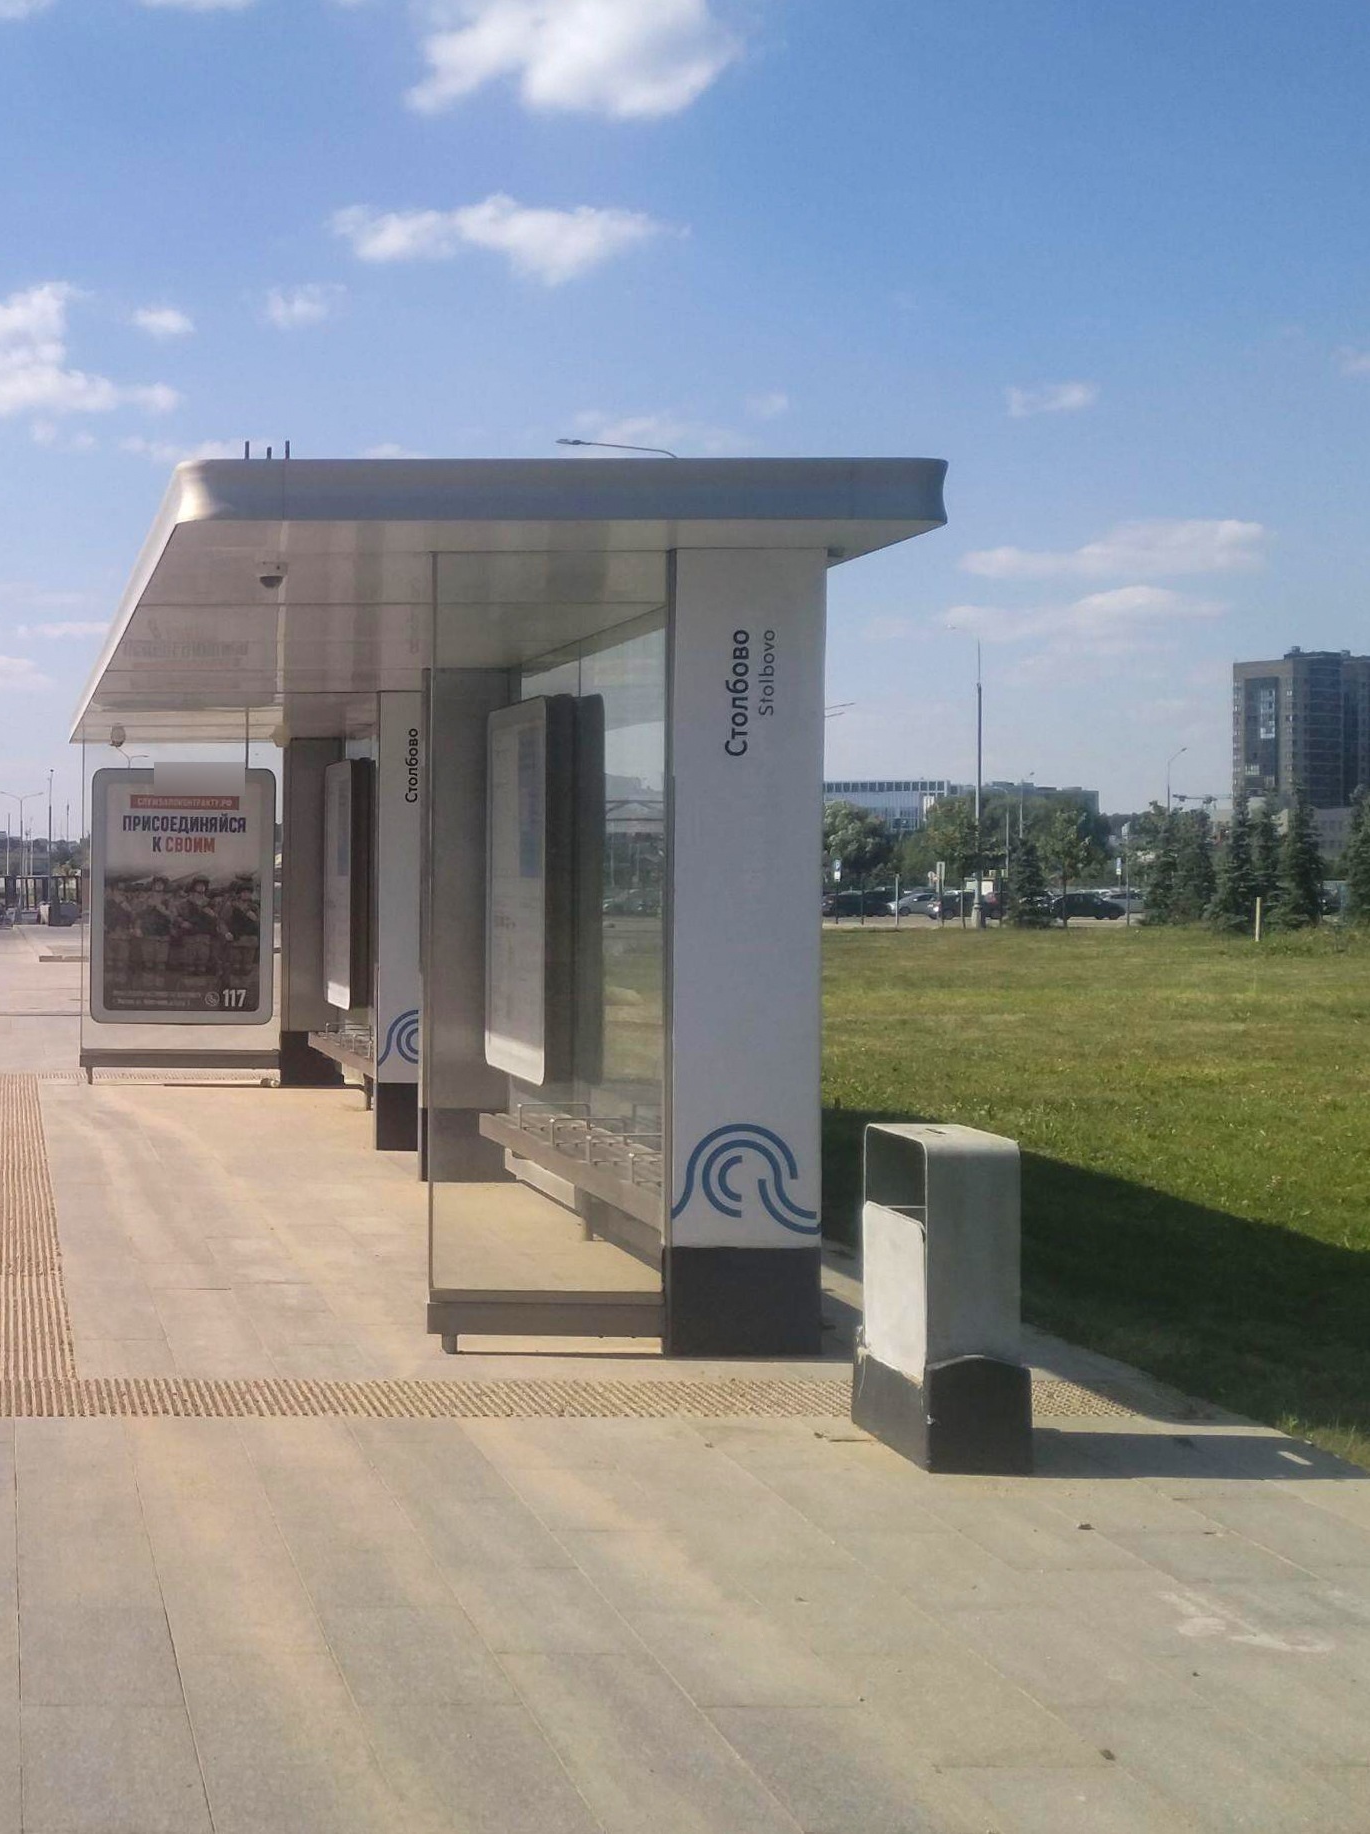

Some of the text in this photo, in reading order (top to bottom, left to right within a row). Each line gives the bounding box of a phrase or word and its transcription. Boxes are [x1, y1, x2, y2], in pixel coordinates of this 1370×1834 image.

[724, 629, 750, 756] Столбово
[759, 629, 776, 716] Stolbovo
[405, 727, 419, 803] Столбово
[123, 813, 246, 834] ПРИСОЕДИНЯЙСЯ
[152, 836, 216, 853] К СВОИМ
[222, 989, 247, 1008] 117
